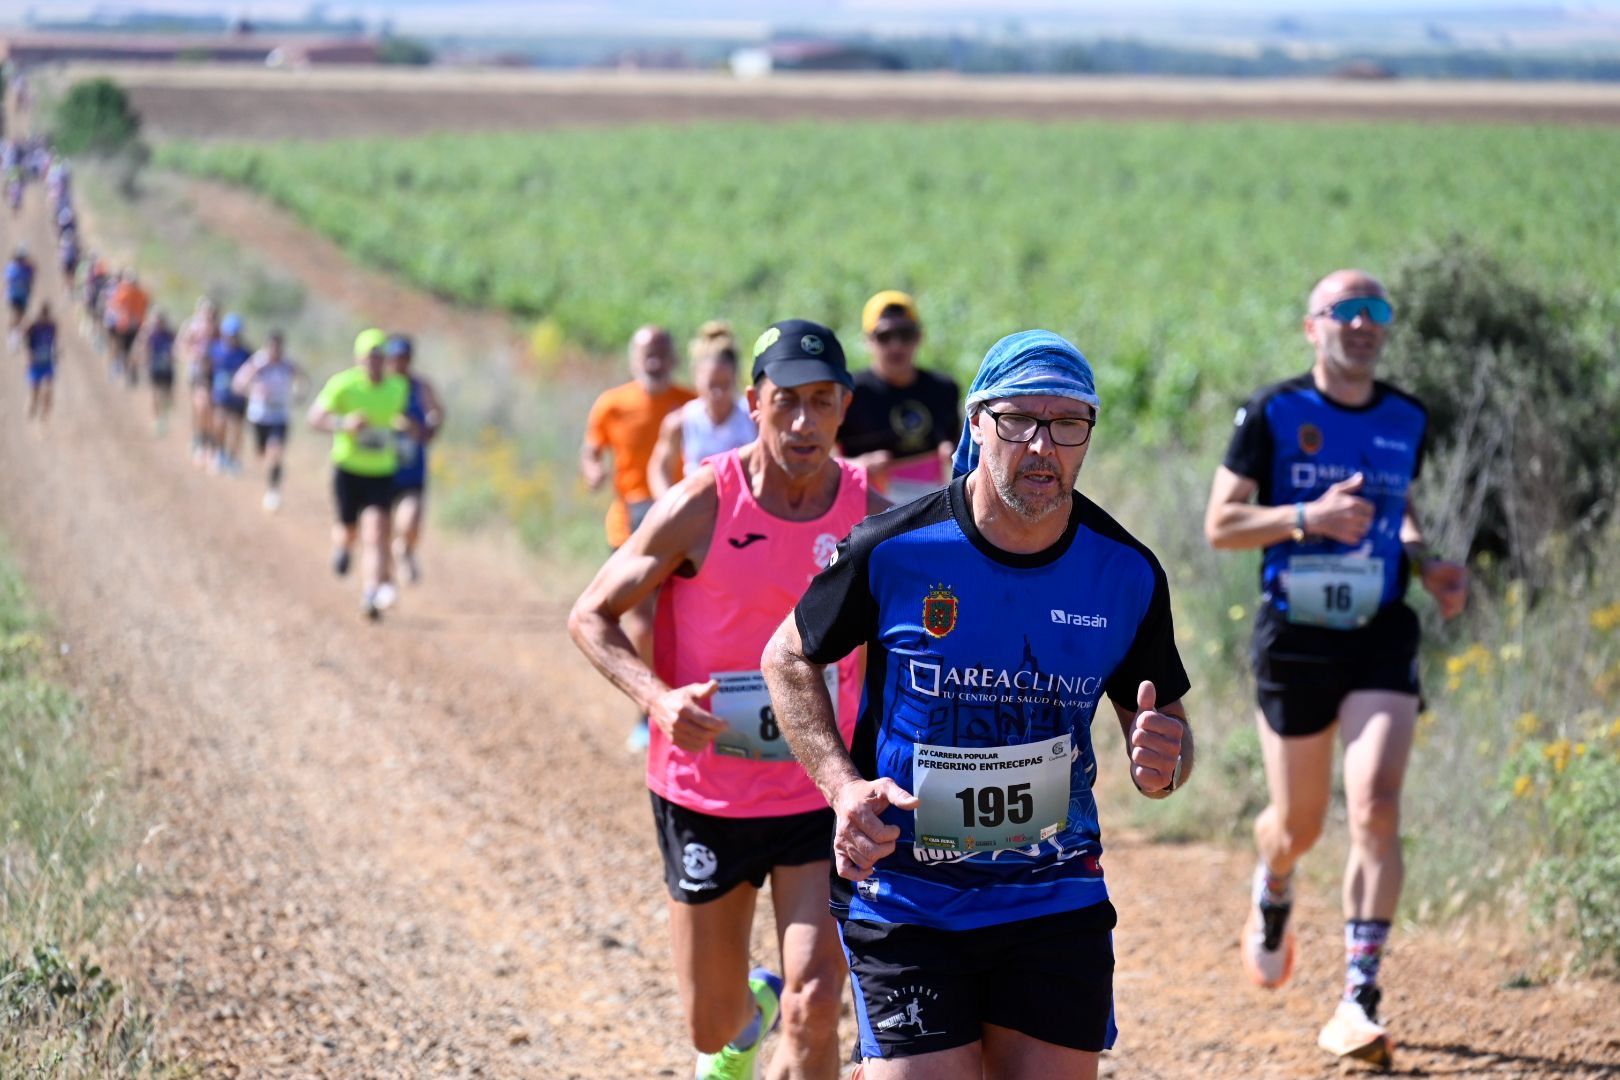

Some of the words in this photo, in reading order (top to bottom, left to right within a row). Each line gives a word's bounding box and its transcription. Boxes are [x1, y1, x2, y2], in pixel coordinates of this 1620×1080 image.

[1323, 584, 1351, 612] 16
[943, 691, 955, 699] TU
[958, 692, 997, 703] CENTRO
[1000, 695, 1014, 703] DE
[1016, 695, 1050, 704] SALUD
[1053, 698, 1066, 709] EN
[917, 759, 977, 771] PEREGRINO
[979, 756, 1043, 771] ENTRECEPAS
[918, 749, 929, 757] XV
[929, 750, 963, 759] CARRERA
[964, 752, 999, 760] POPULAR
[955, 782, 1034, 828] 195
